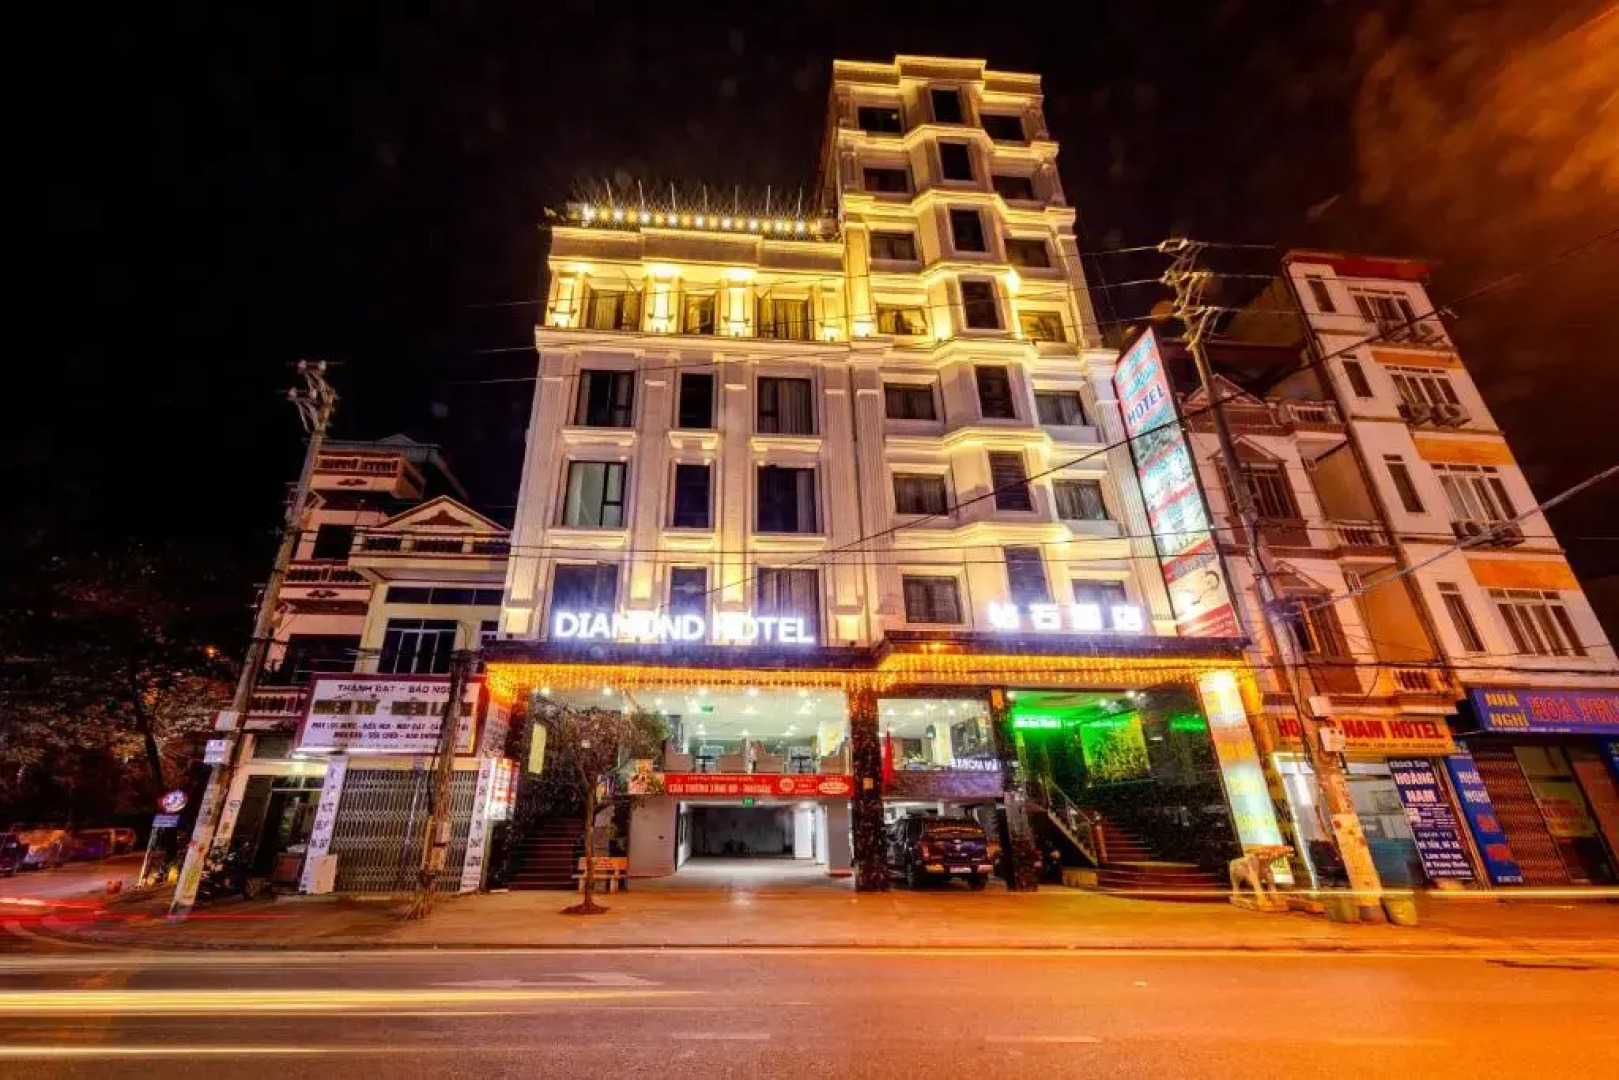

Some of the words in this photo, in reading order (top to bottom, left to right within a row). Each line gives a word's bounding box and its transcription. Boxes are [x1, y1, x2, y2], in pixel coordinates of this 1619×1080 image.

[1127, 384, 1165, 427] HOTEL
[555, 611, 705, 641] DIAMOND
[712, 614, 815, 643] HOTEL
[1342, 720, 1386, 738] NAM
[1388, 720, 1444, 739] HOTEL
[1405, 790, 1438, 802] NAM
